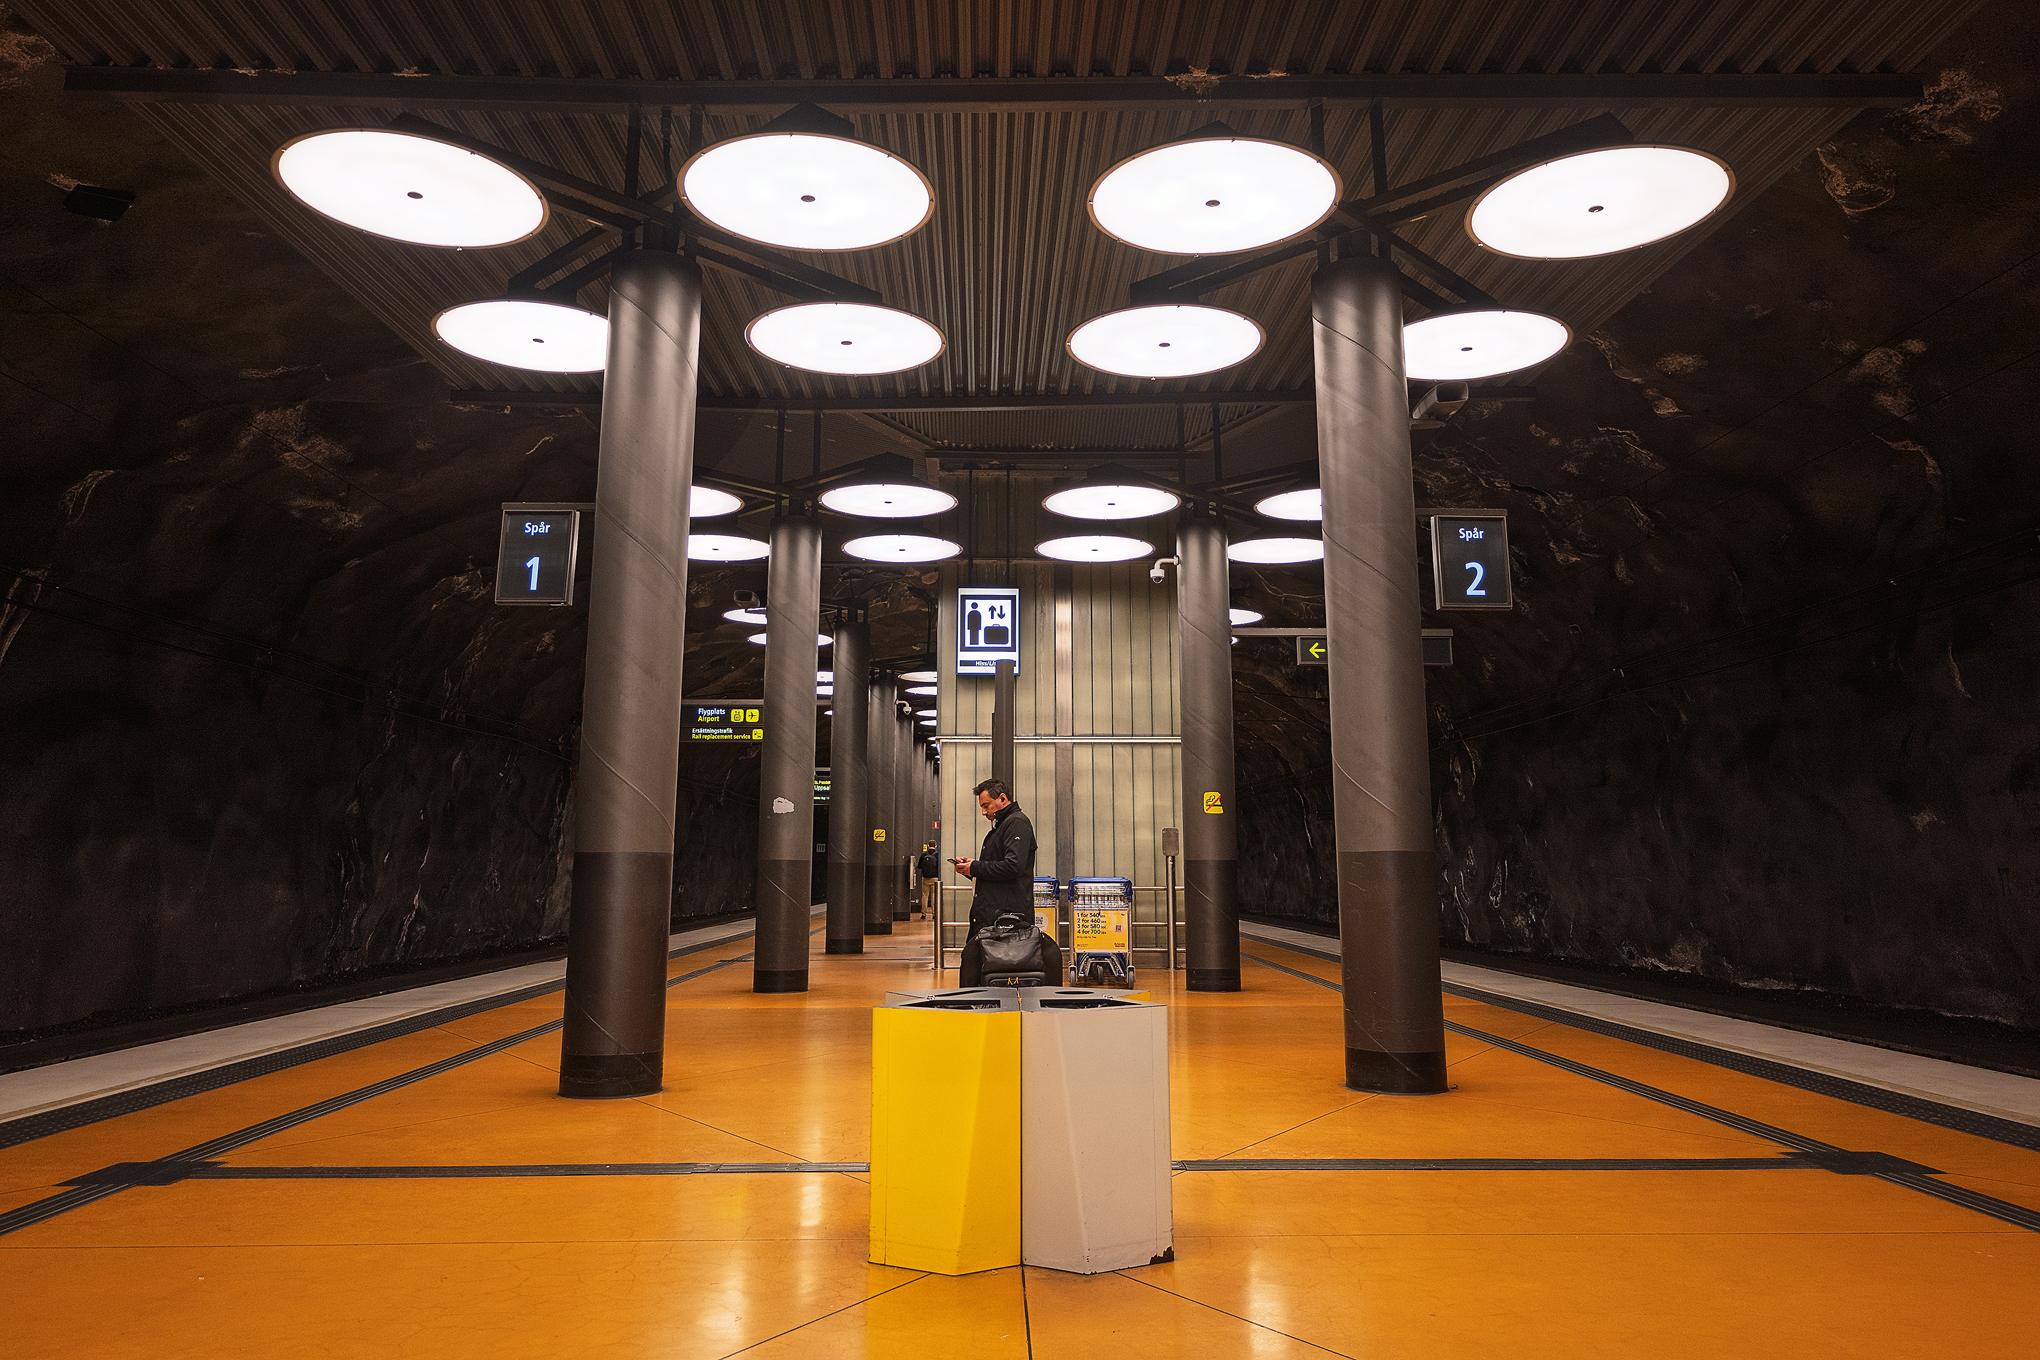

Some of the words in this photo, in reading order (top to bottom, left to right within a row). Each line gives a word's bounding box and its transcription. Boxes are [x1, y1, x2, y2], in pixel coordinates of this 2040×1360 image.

[524, 521, 550, 536] Spår
[1459, 527, 1484, 541] Spår
[526, 556, 540, 591] 1
[1465, 561, 1486, 596] 2
[698, 708, 726, 716] Flygplats
